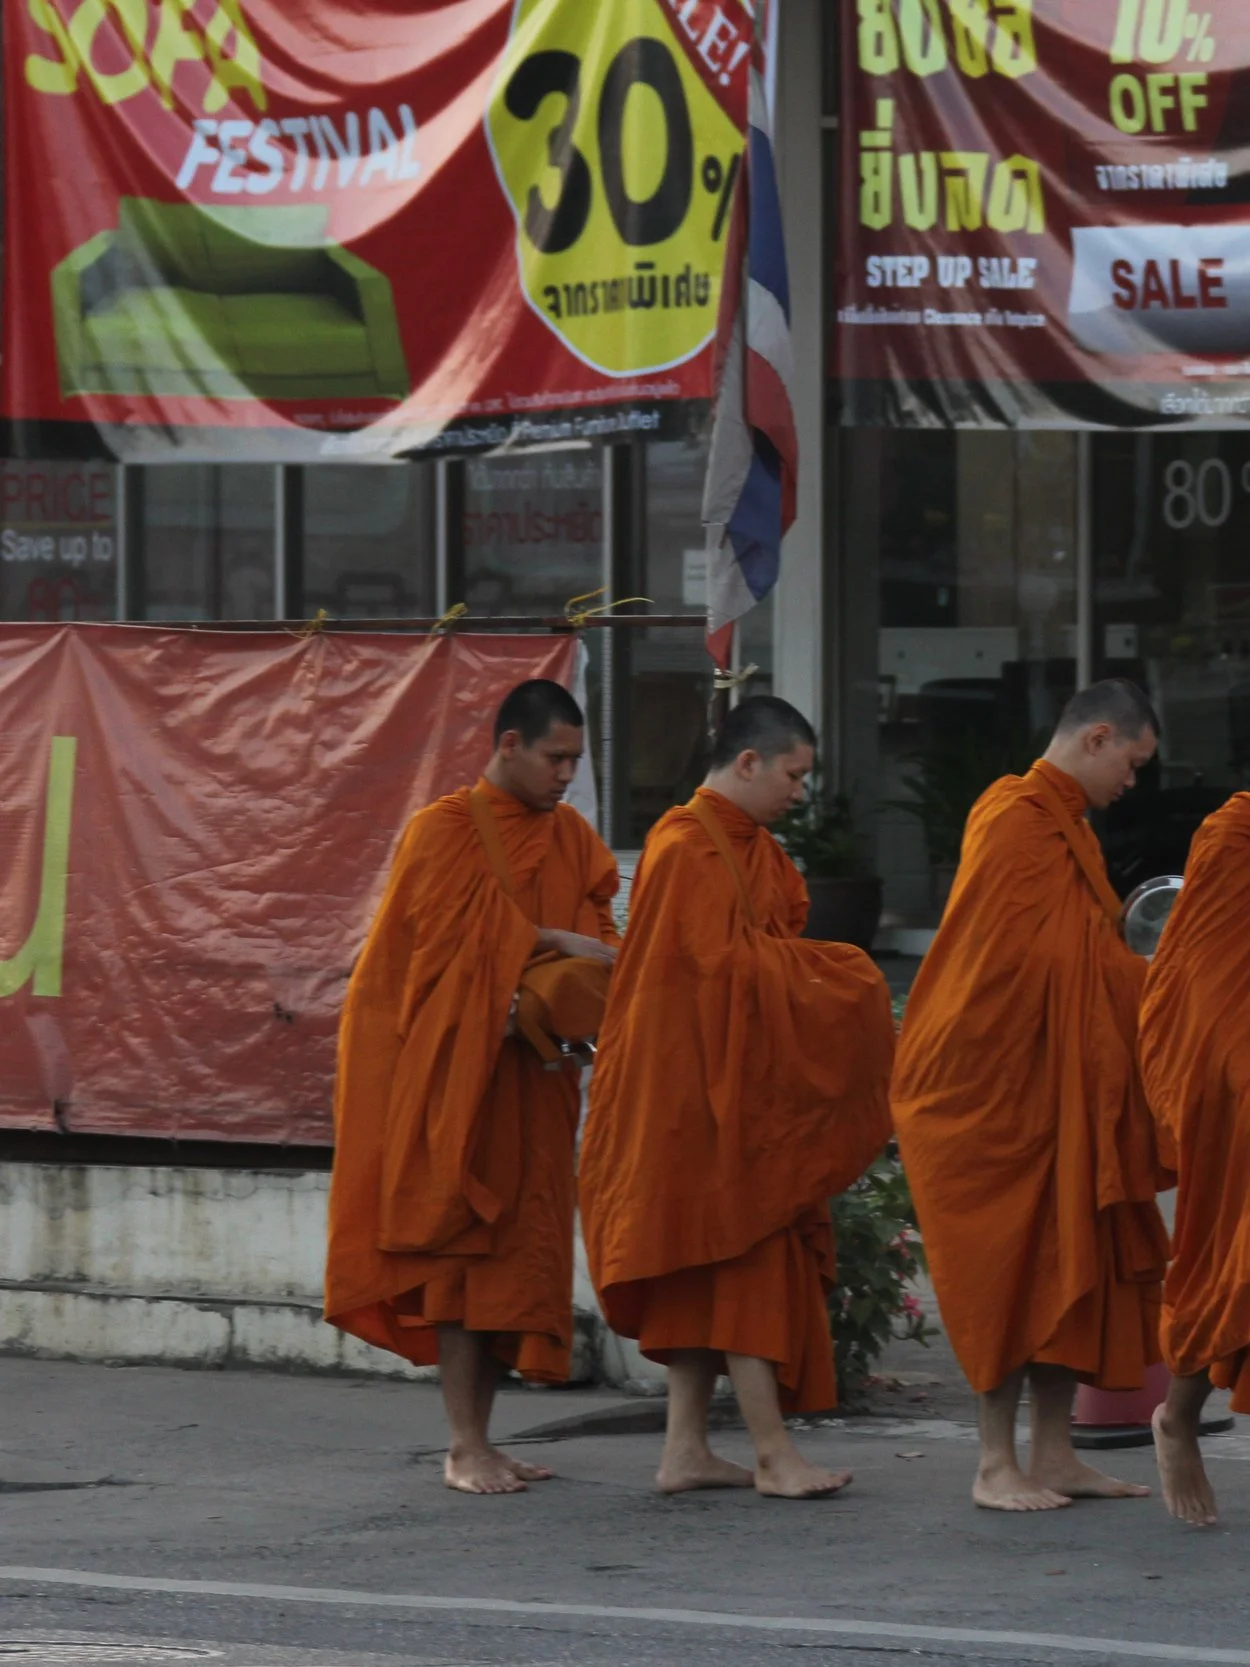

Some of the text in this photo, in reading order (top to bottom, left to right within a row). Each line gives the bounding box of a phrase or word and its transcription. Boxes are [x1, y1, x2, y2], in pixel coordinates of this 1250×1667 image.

[25, 0, 267, 112] SOFA
[1109, 71, 1209, 134] OFF
[176, 103, 428, 195] FESTIVAL
[866, 256, 1038, 289] STEP UP SALE
[1111, 258, 1227, 310] SALE
[0, 472, 113, 522] PRICE
[1, 528, 113, 568] Save up to
